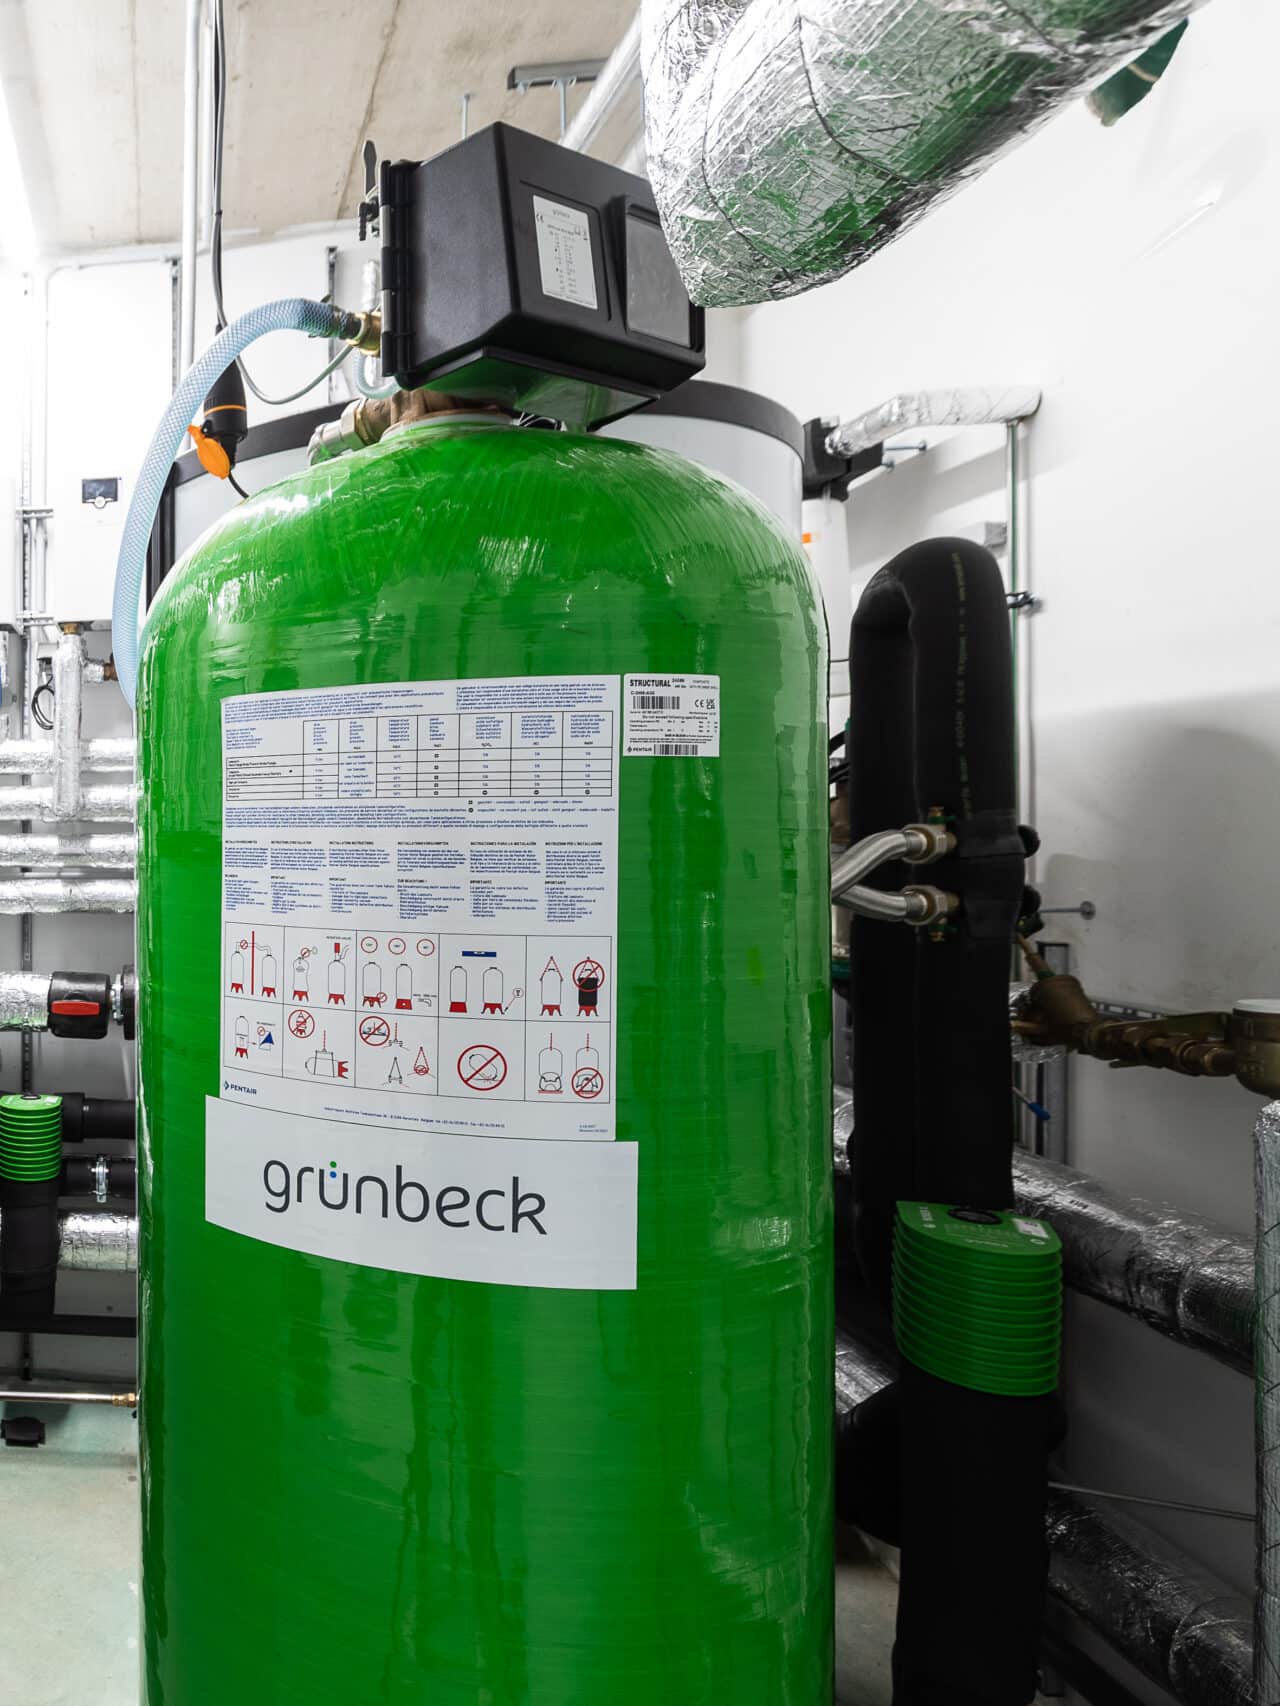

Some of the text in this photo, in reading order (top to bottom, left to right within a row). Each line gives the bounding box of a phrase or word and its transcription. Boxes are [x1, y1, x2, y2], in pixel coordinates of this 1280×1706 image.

[630, 679, 671, 687] STRUCTURAL
[230, 1083, 257, 1095] PENTAIR
[263, 1159, 548, 1236] grünbeck
